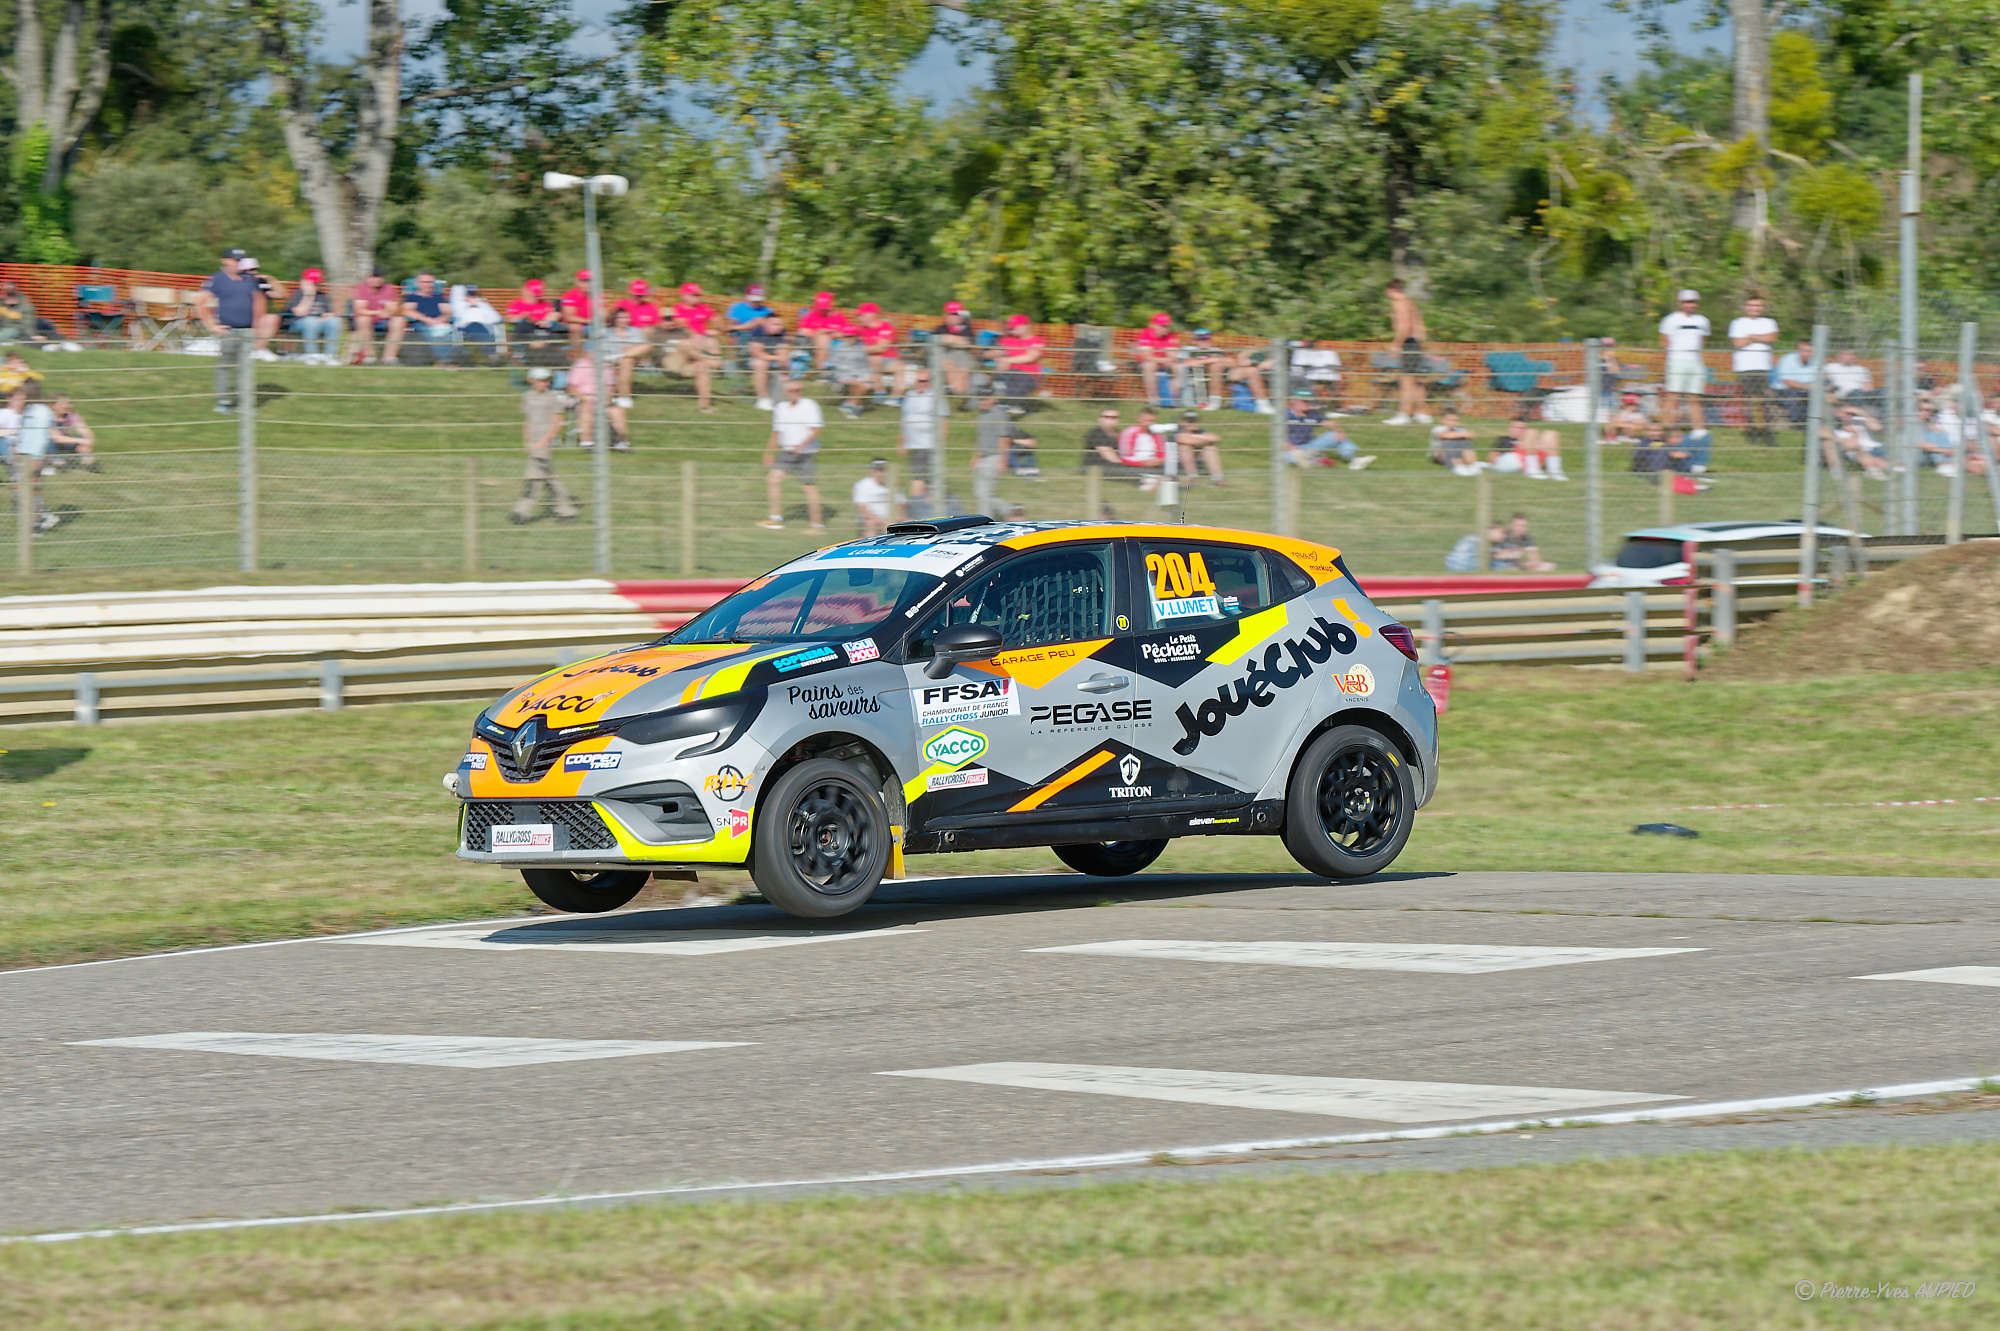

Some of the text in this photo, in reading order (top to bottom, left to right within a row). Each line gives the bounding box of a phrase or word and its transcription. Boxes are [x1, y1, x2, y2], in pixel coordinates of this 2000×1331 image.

[1145, 552, 1216, 599] 204
[1155, 598, 1214, 617] V.LUMET
[1169, 633, 1197, 645] Le Petit
[849, 647, 879, 662] MOLY
[989, 649, 1076, 667] GARAGE PEU
[1140, 642, 1202, 660] Pêcheur
[786, 684, 864, 705] Pains des
[923, 681, 1001, 705] FFSA
[517, 694, 596, 713] YACCO
[808, 695, 881, 720] saveurs
[922, 705, 970, 717] CHAMPIONNAT
[982, 701, 1009, 709] FRANCE
[922, 708, 1009, 725] RALLYCROSS JUNIOR
[1030, 699, 1152, 726] PEGASE
[1116, 722, 1153, 730] GLISSE
[931, 738, 981, 757] YACCO
[565, 753, 622, 765] COOPER
[589, 761, 617, 770] TIRES
[931, 773, 967, 787] RALLYCROSS
[1108, 785, 1152, 798] TRITON
[495, 830, 532, 844] RALLYCROSS
